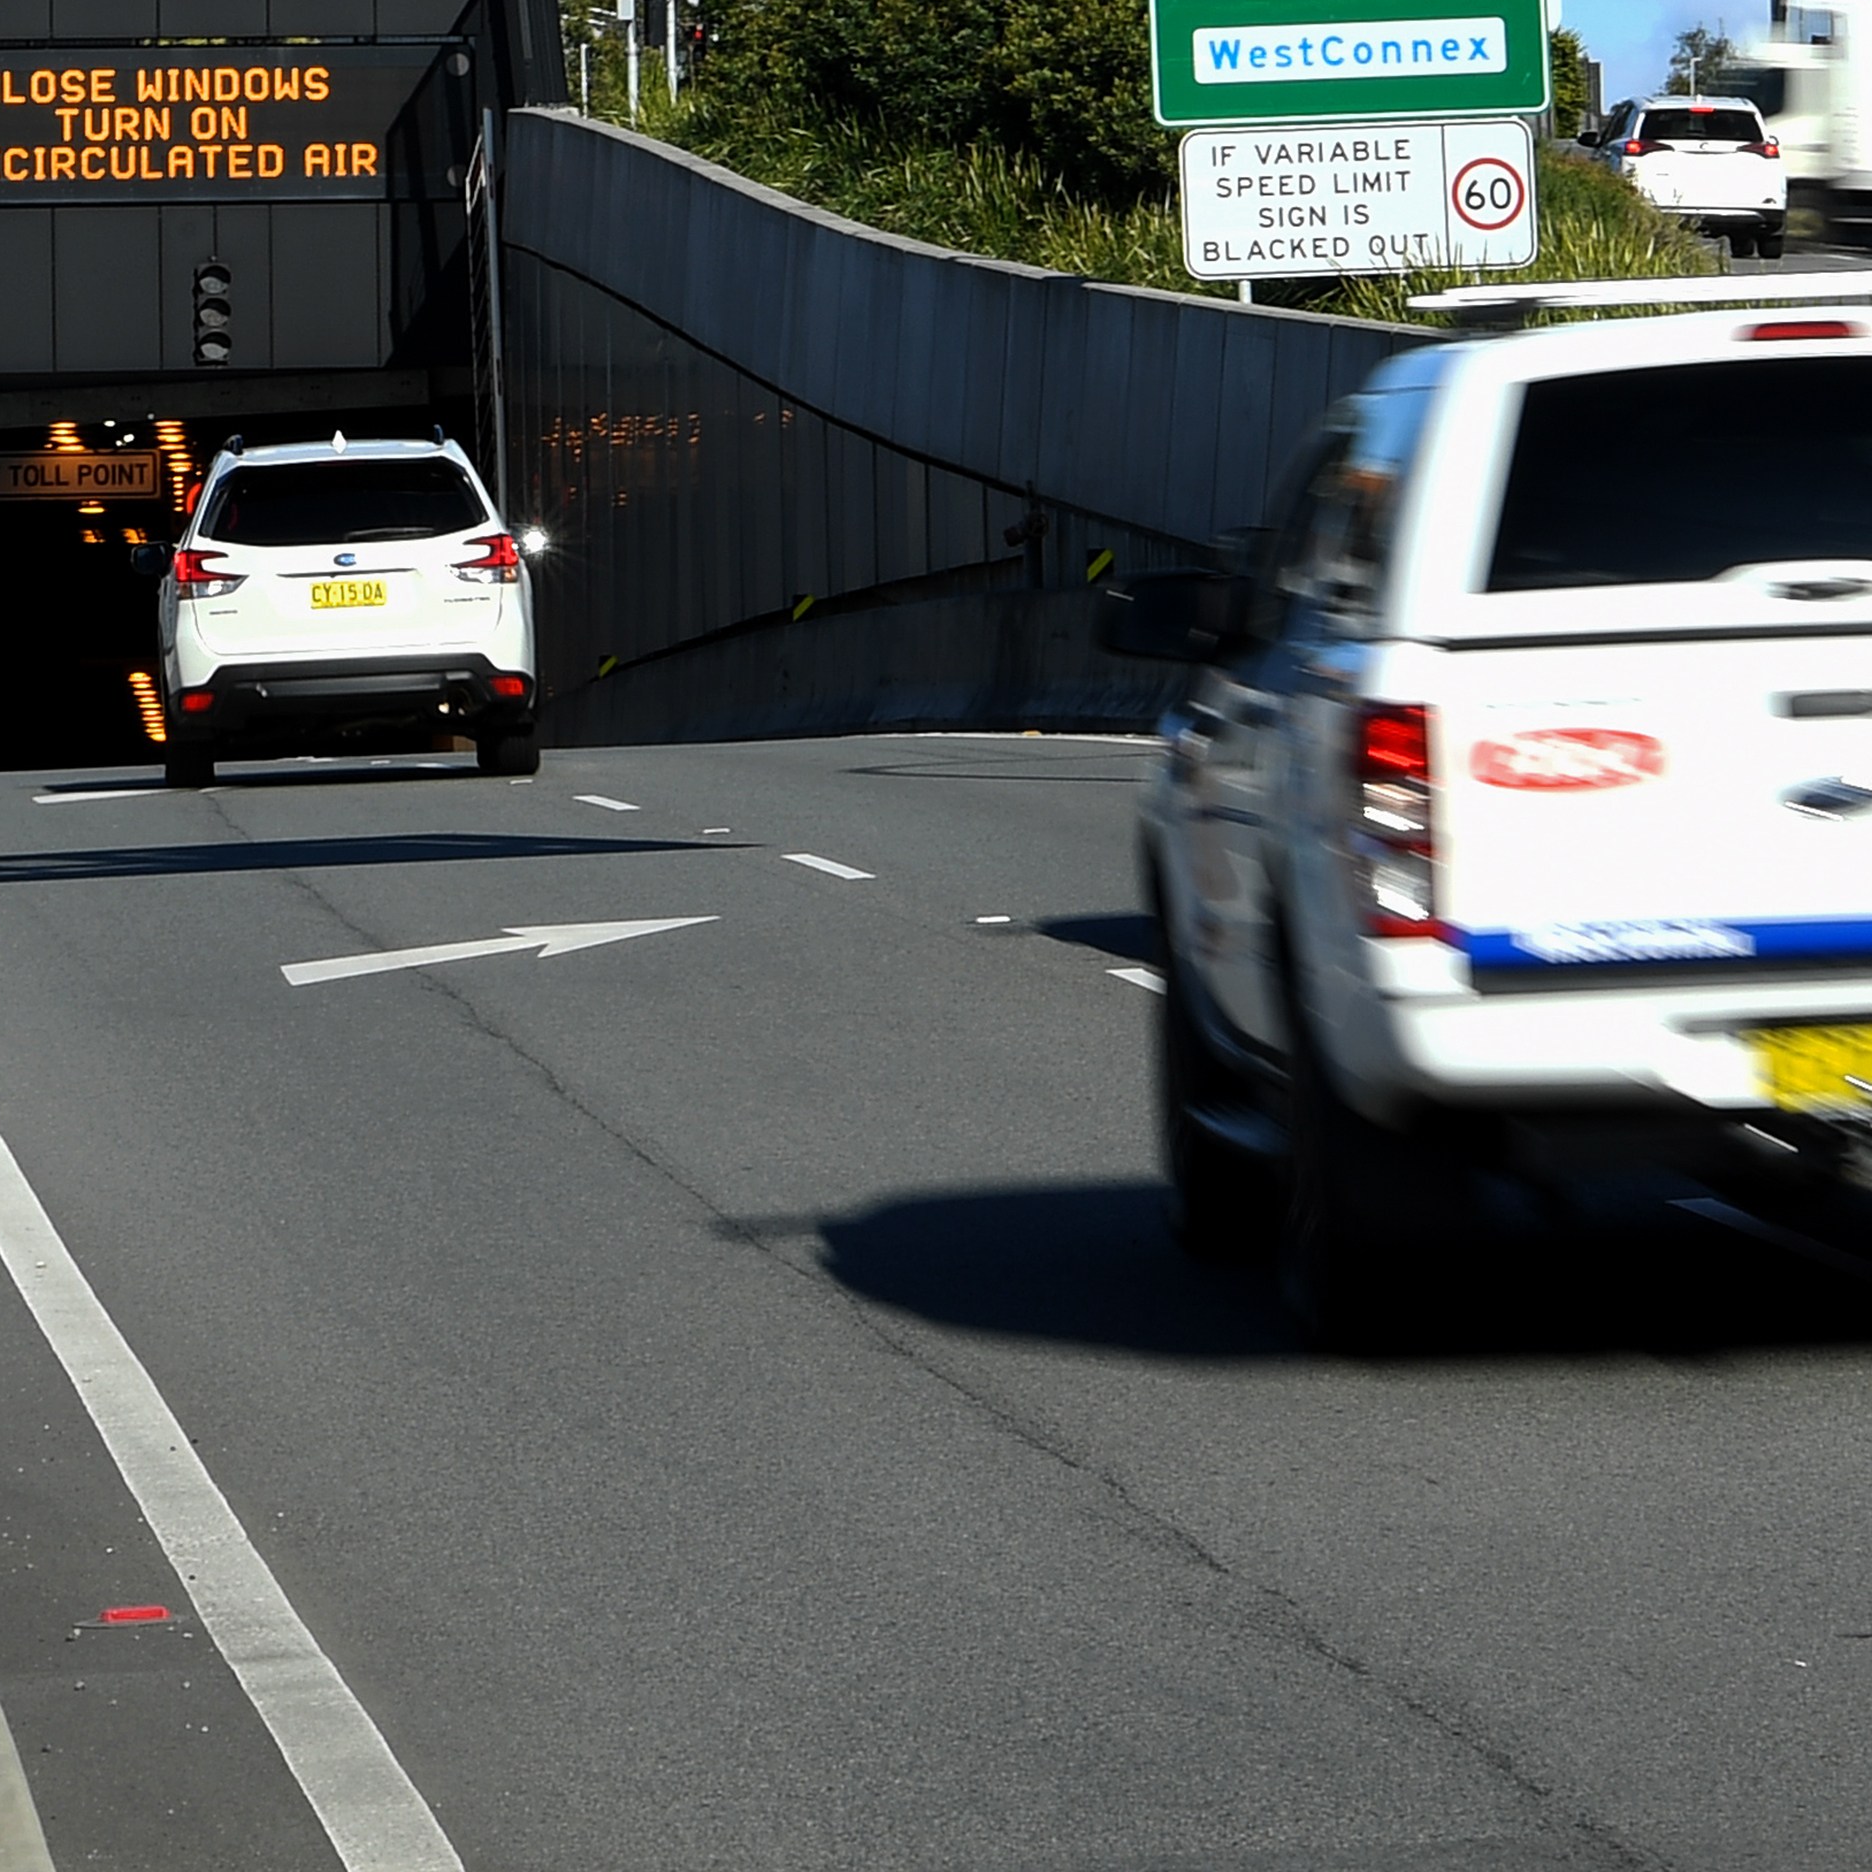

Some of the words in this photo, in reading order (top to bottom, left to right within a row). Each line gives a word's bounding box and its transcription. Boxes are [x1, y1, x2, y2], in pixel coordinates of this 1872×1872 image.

[1209, 35, 1489, 70] WestConnex
[137, 67, 330, 103] WINDOWS
[54, 107, 171, 142] TURN
[191, 106, 248, 140] ON
[304, 143, 378, 177] AIR
[1212, 145, 1236, 166] IF
[1254, 139, 1411, 165] VARIABLE
[1216, 175, 1316, 198] SPEED
[1334, 171, 1411, 194] LIMIT
[1465, 178, 1512, 210] 60
[1258, 206, 1327, 229] SIGN
[1344, 204, 1370, 226] IS
[1203, 236, 1350, 262] BLACKED
[1369, 233, 1429, 258] OUT
[8, 464, 69, 487] TOLL
[78, 463, 149, 486] POINT
